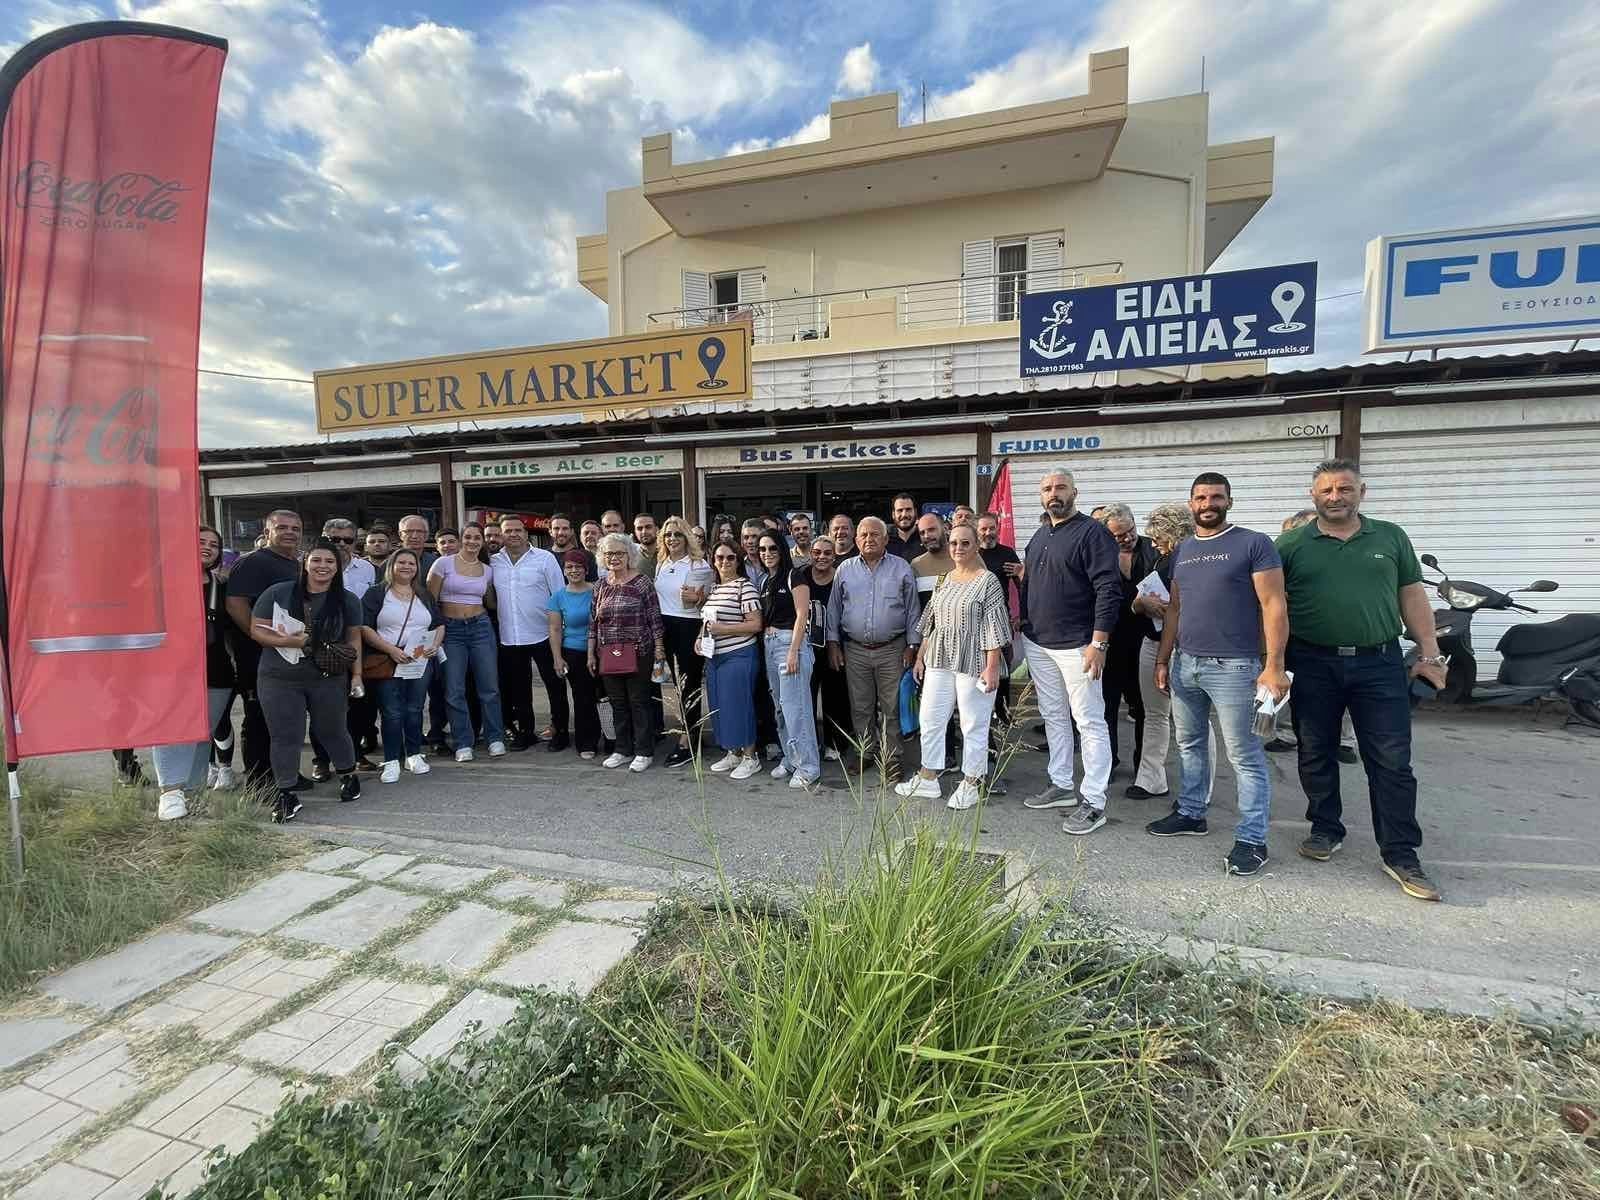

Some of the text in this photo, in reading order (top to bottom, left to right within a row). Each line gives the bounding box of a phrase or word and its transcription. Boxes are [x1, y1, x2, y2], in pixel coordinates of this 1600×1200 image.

[1116, 279, 1212, 321] ΕΙΔΗ
[1086, 314, 1257, 362] ΑΛΙΕΙΑΣ
[1234, 345, 1310, 358] www.tatarakis.gr
[333, 350, 683, 422] SUPER MARKET
[740, 440, 917, 462] Bus Tickets
[999, 436, 1101, 453] FURUNO
[1287, 424, 1328, 437] ICOM
[470, 461, 541, 477] Fruits
[556, 458, 593, 472] ALC
[615, 454, 664, 468] Beer
